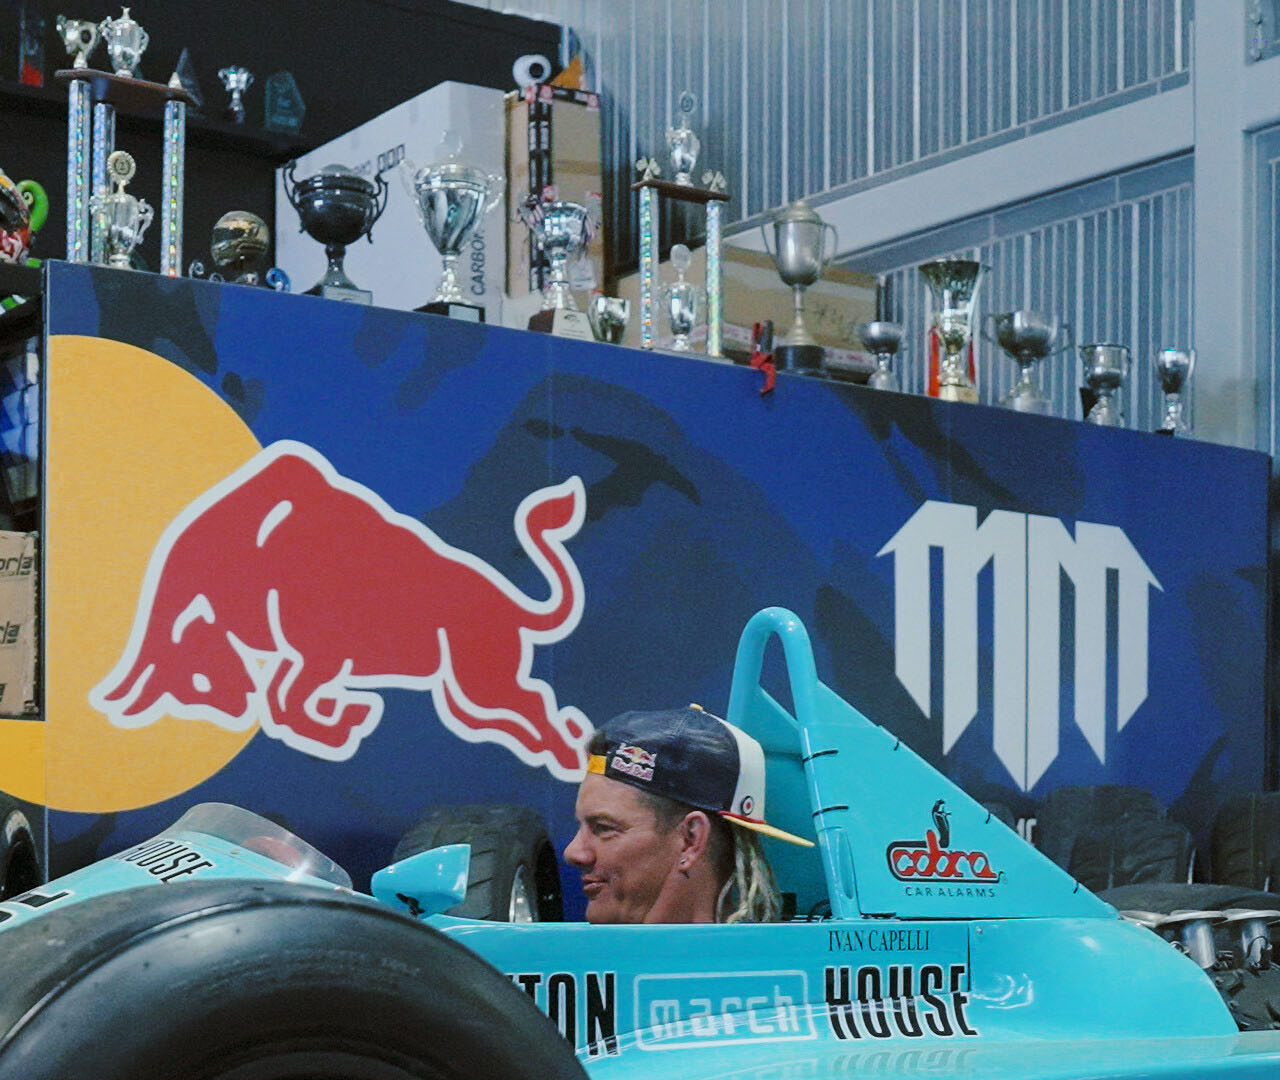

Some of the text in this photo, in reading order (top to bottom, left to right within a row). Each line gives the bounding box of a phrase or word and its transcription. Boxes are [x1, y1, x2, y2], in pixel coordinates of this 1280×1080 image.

[905, 886, 996, 898] CAR ALARMS
[828, 929, 931, 952] IVAN CAPELLI
[825, 965, 980, 1041] HOUSE
